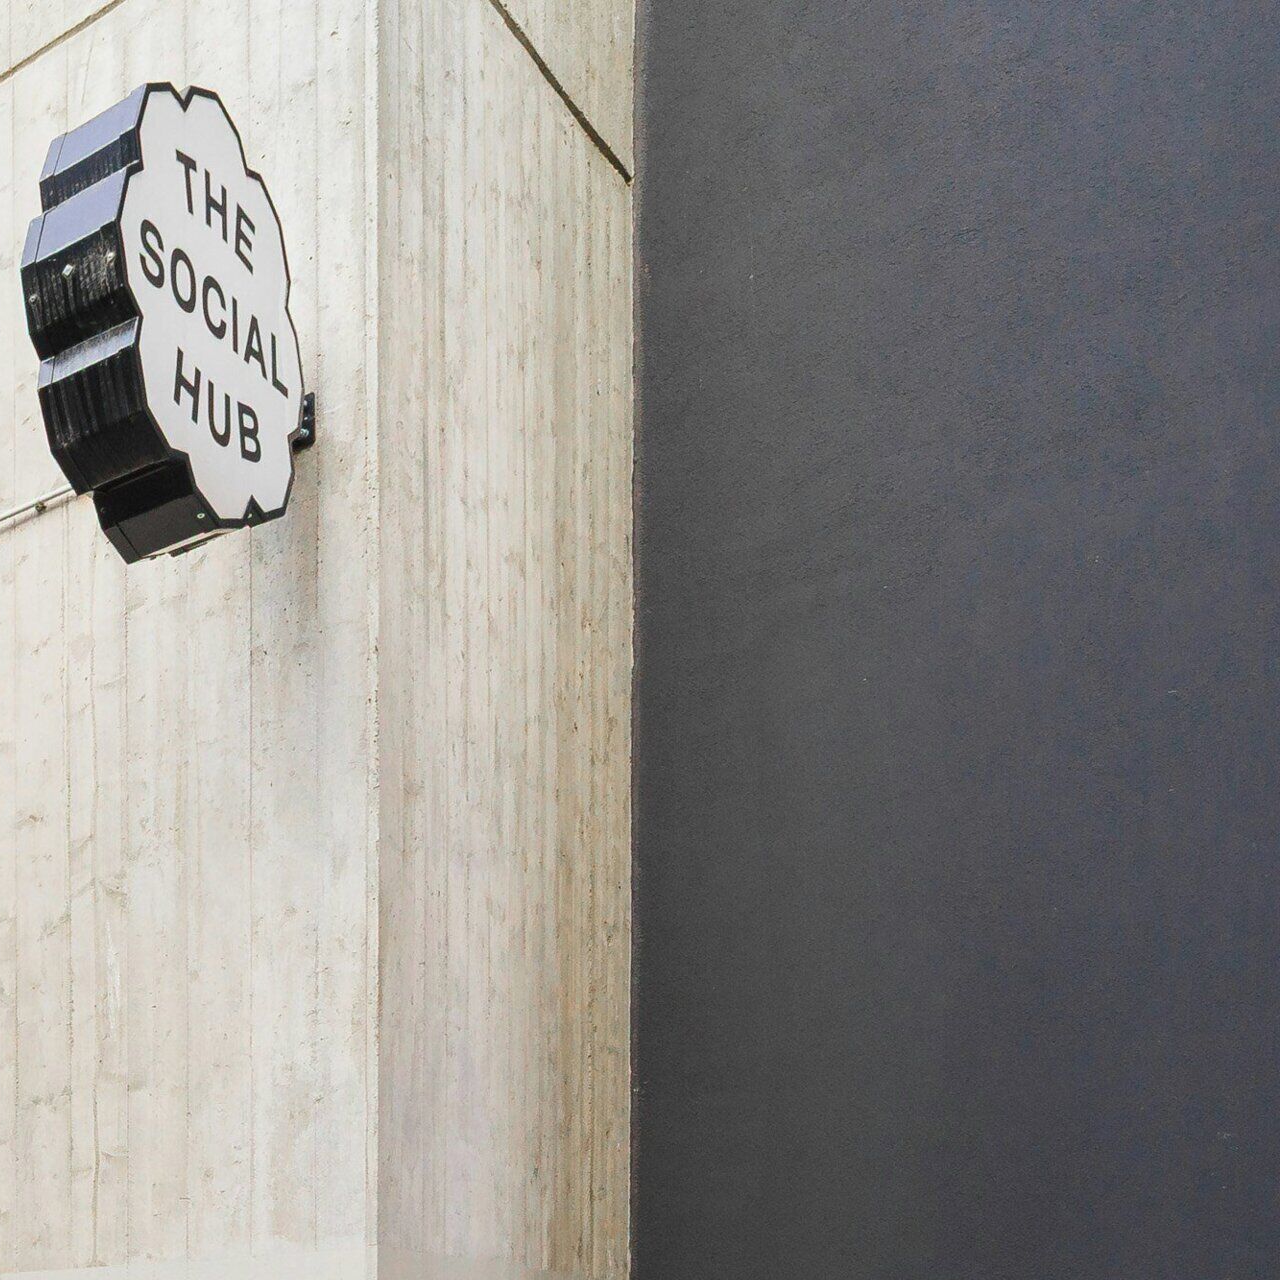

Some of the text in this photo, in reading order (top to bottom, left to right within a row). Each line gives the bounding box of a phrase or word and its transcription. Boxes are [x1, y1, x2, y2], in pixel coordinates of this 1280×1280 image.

[175, 148, 256, 275] THE
[139, 219, 289, 399] SOCIAL
[173, 346, 262, 464] HUB
